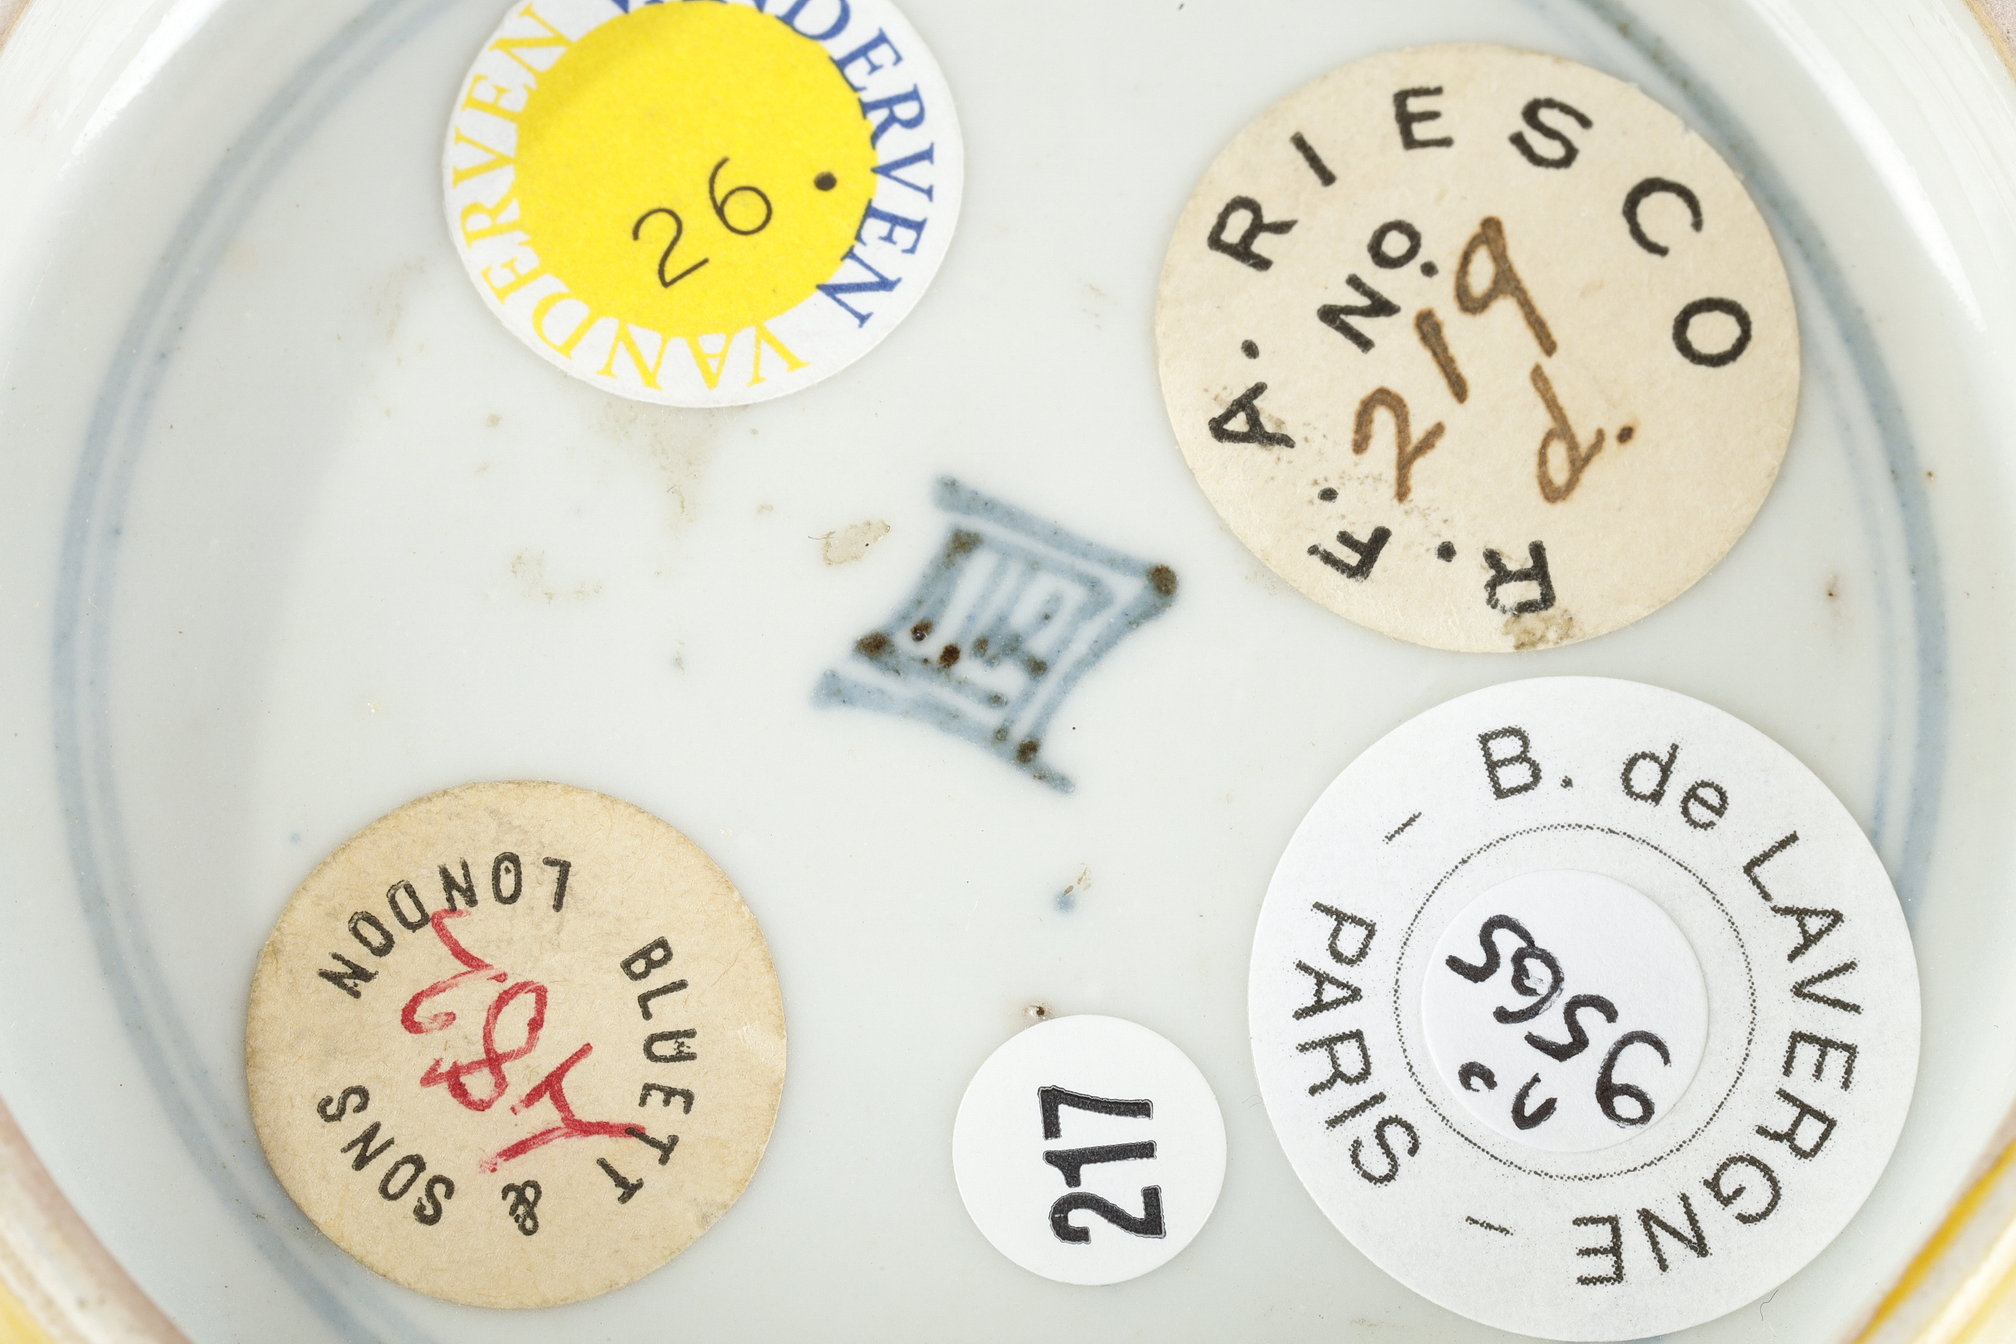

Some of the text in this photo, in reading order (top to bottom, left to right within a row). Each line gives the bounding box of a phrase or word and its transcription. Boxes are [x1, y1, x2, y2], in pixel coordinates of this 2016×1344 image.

[451, 3, 810, 391] VANDERVEN
[1206, 86, 1752, 368] RIESCO
[1352, 215, 1557, 502] 219
[1476, 727, 1574, 801] B.
[1620, 743, 1730, 830] de
[317, 851, 573, 1000] LONDON
[1290, 900, 1421, 1186] PARIS
[1570, 831, 1863, 1288] LAVERGNE
[315, 935, 699, 1237] BLUETT & SONS
[1036, 1084, 1167, 1245] 217
